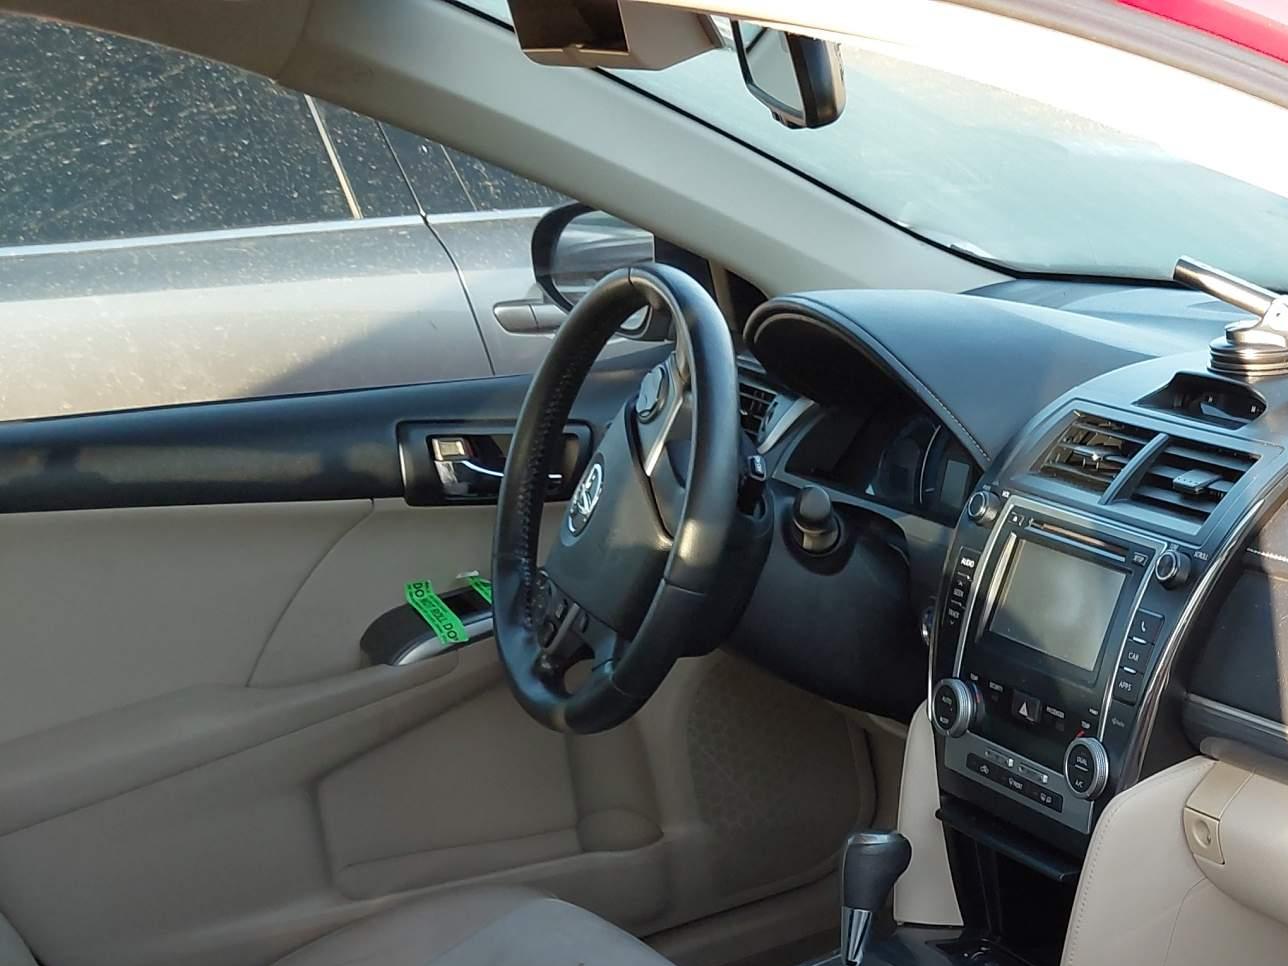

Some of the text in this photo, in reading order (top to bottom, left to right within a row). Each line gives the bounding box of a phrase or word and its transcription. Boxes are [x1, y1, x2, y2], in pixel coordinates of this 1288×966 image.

[960, 557, 975, 568] AUDIO
[412, 582, 425, 598] DO
[1128, 652, 1139, 662] CAR
[1118, 680, 1132, 691] APPS
